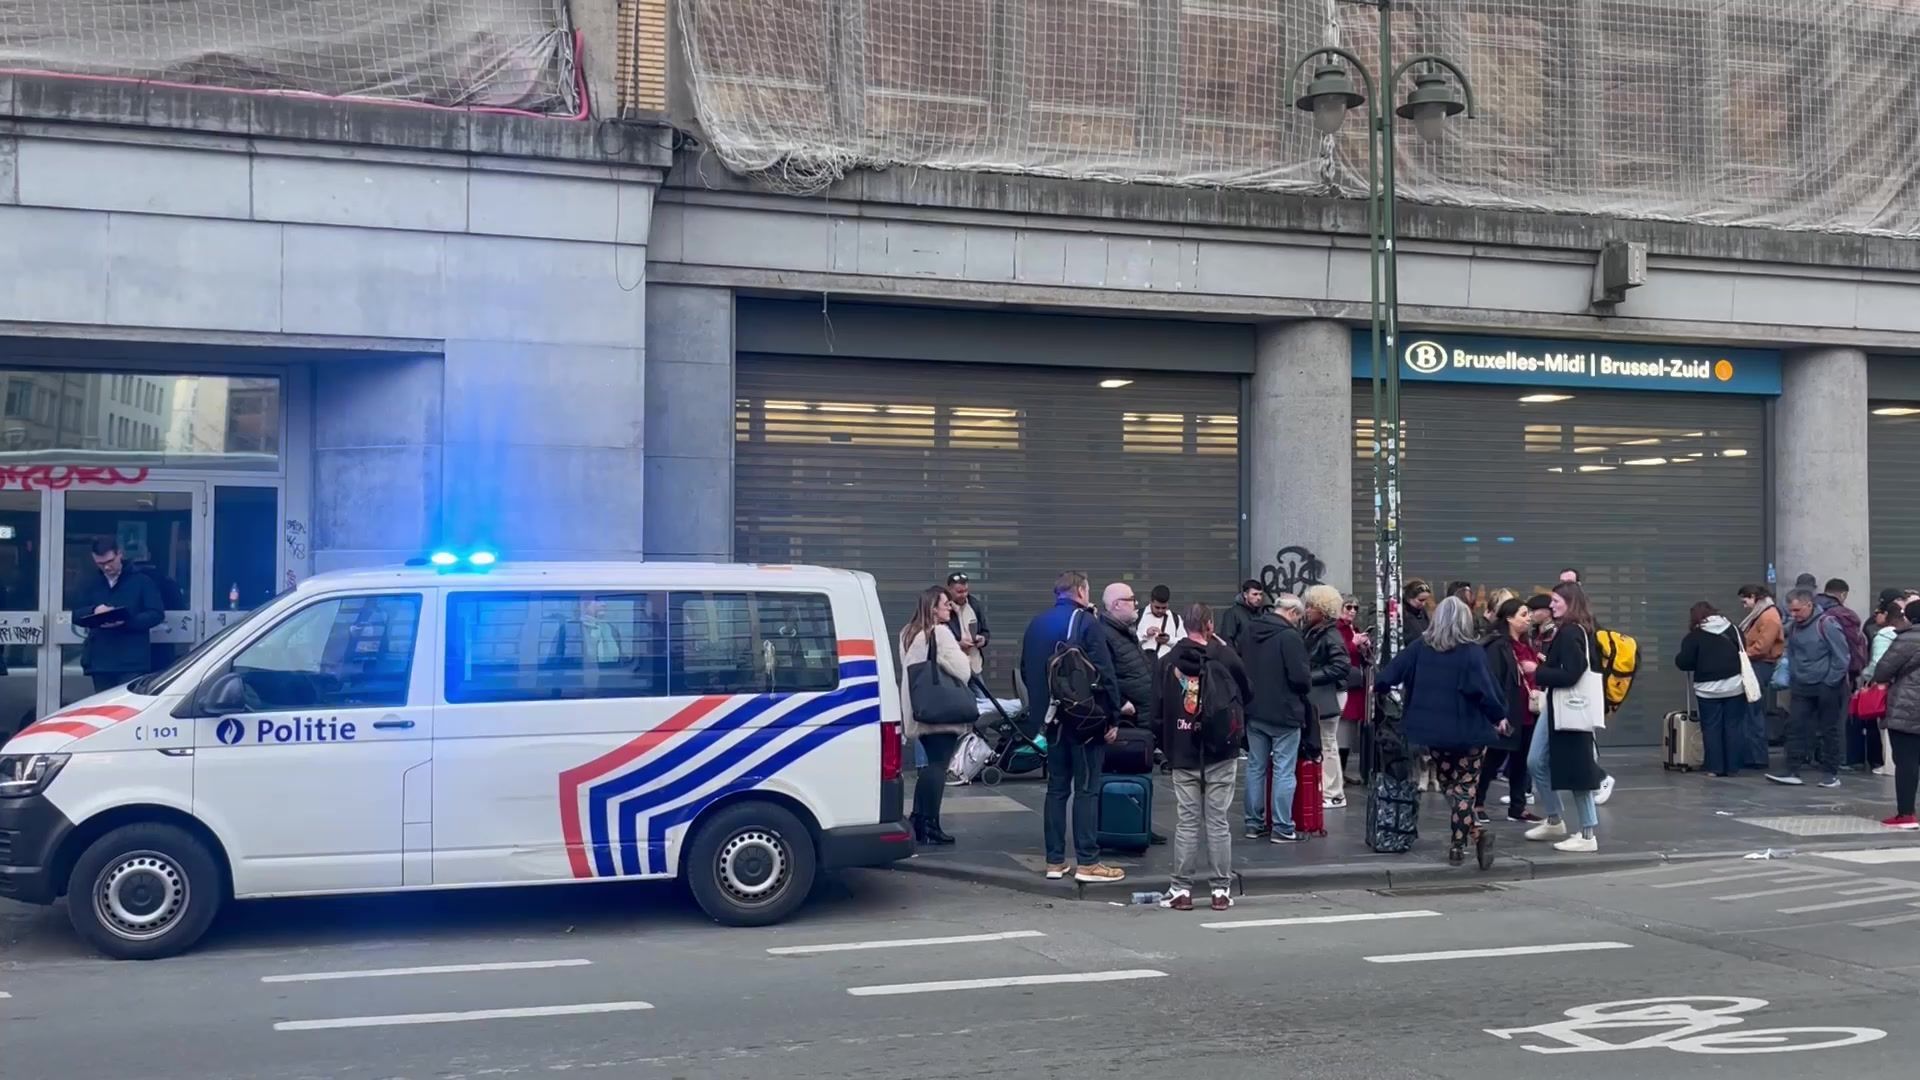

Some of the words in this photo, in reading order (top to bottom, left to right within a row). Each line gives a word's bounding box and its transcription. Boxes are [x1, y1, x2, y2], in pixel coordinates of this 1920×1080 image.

[1453, 349, 1585, 373] Bruxelles-Midi
[1600, 355, 1710, 378] Brussel-Zuid
[153, 727, 178, 738] 101
[257, 717, 356, 743] Politie
